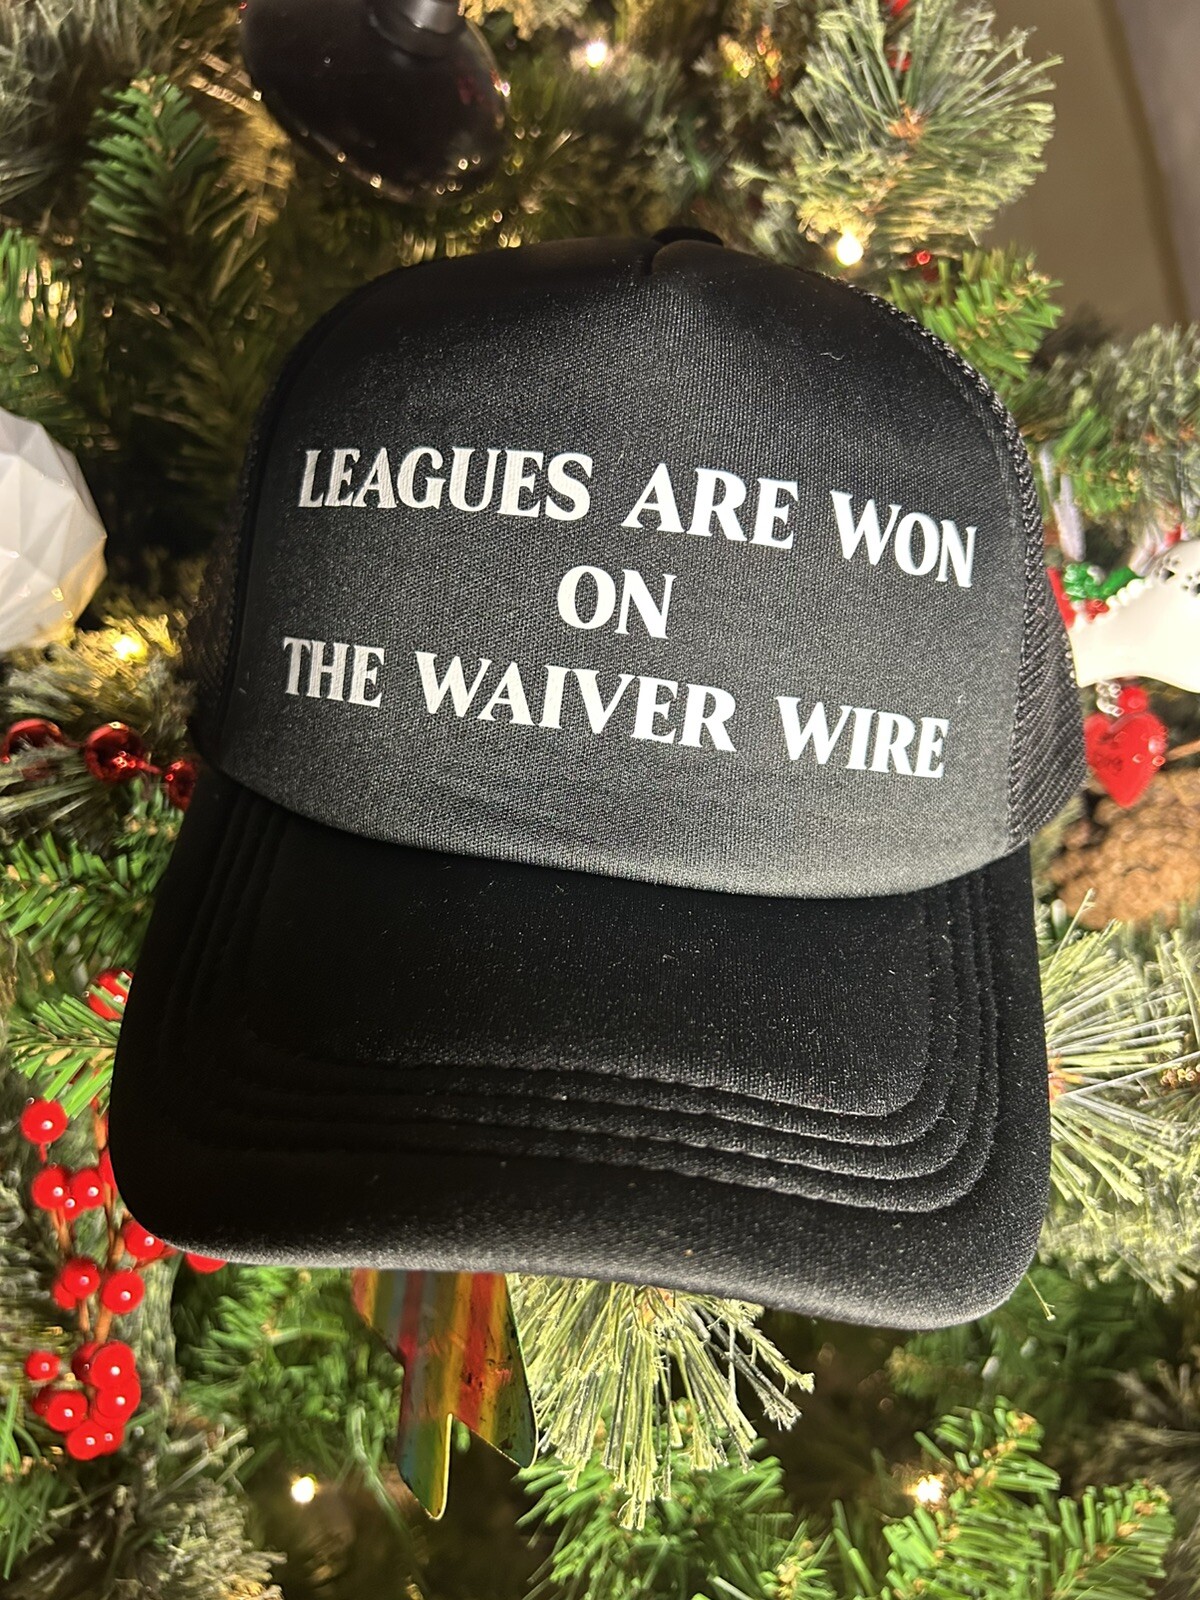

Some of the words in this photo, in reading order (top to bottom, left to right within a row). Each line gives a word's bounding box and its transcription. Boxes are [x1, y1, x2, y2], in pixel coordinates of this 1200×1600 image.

[299, 446, 594, 522] LEAGUES
[619, 463, 799, 551] ARE
[829, 489, 978, 589] WON
[556, 565, 677, 640] ON
[282, 637, 386, 708] THE
[415, 650, 737, 752] WAIVER
[776, 695, 950, 779] WIRE
